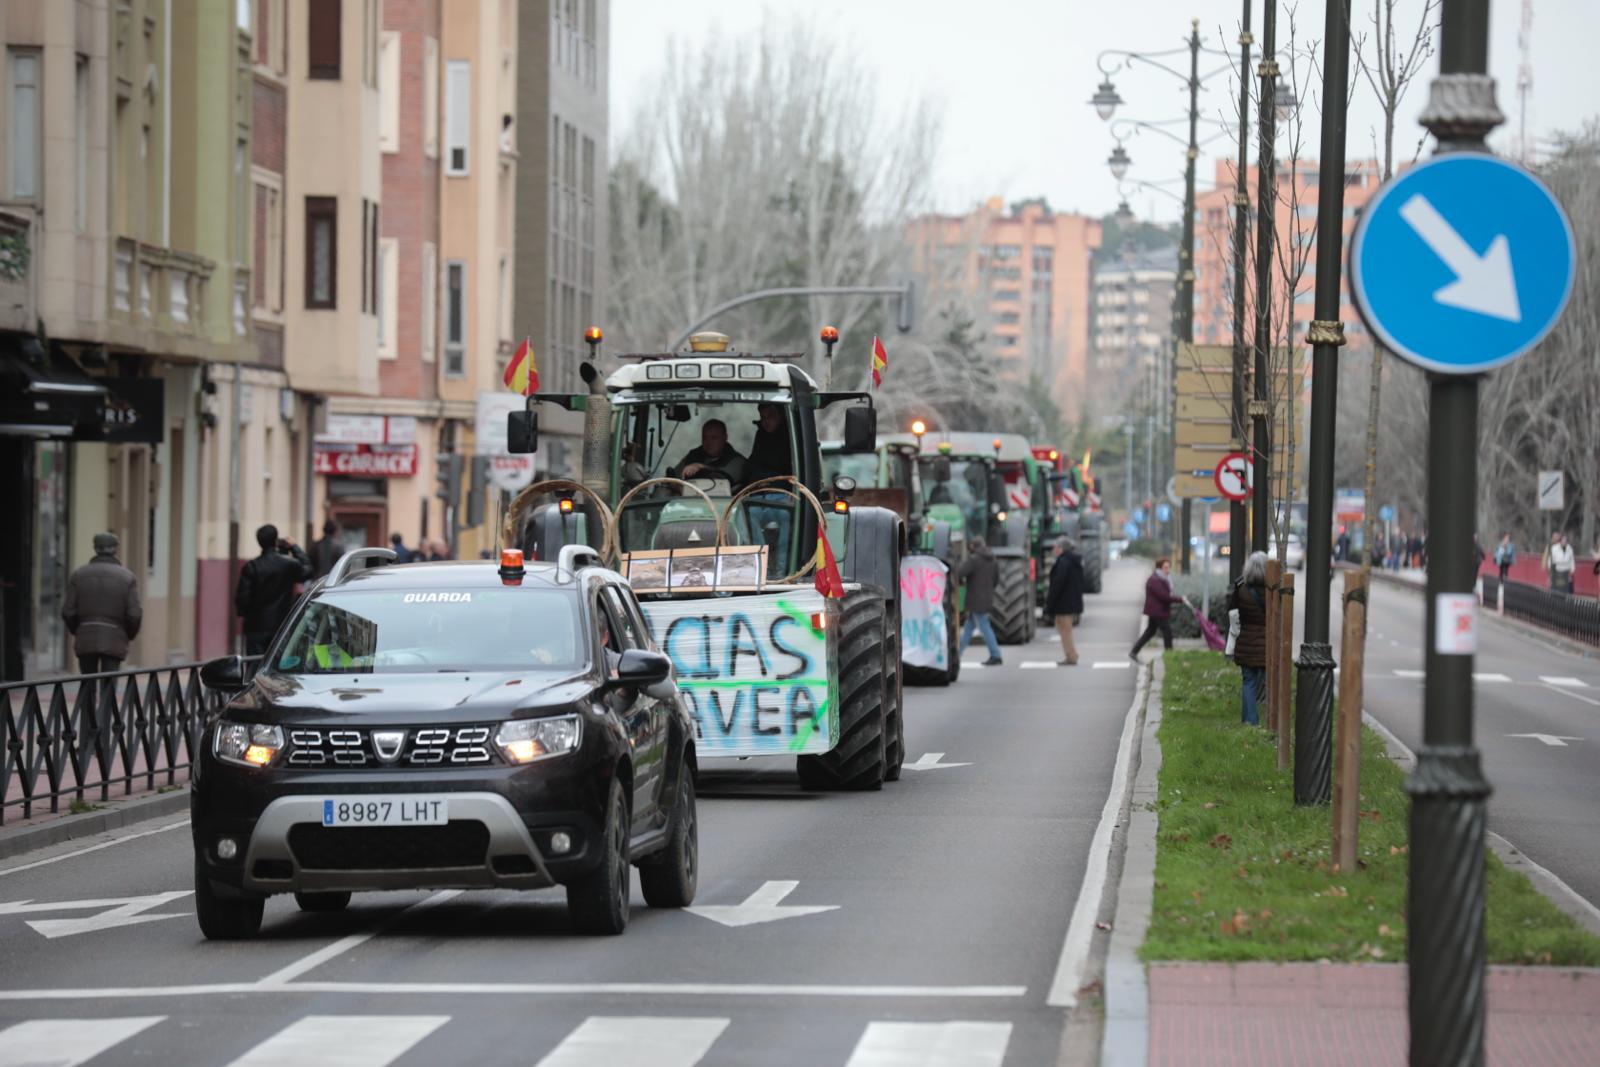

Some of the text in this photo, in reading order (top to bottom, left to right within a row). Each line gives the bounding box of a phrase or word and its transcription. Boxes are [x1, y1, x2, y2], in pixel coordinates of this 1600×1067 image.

[644, 611, 815, 681] CIAS
[338, 801, 441, 822] 8987 LHT
